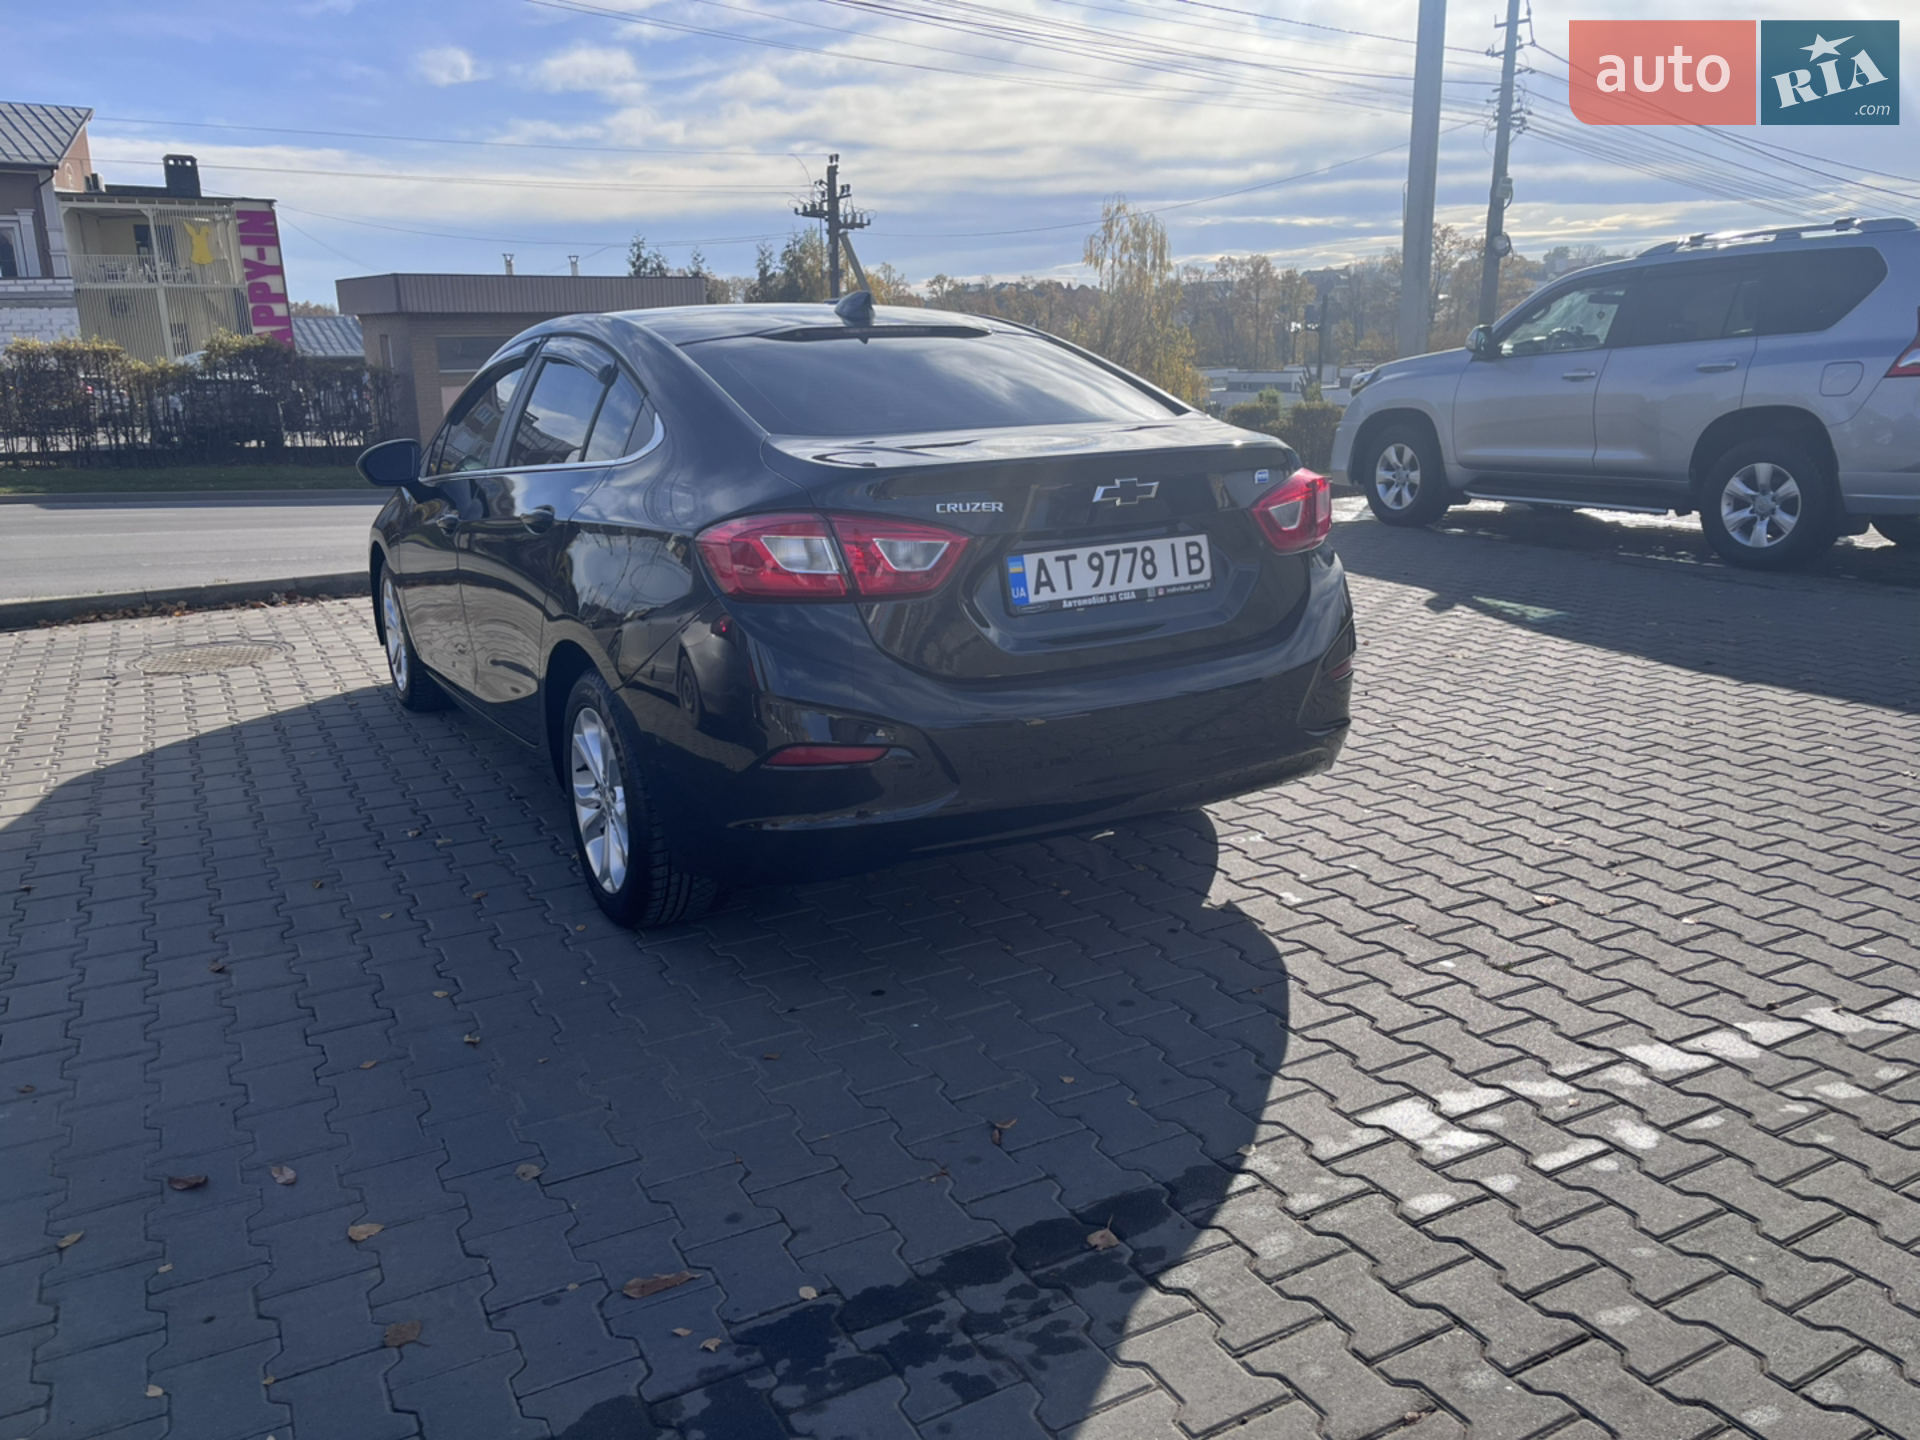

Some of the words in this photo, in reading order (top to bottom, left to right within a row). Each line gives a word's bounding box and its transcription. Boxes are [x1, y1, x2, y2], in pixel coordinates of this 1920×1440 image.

[935, 502, 1004, 514] CRUZER
[1033, 554, 1077, 596] AT
[1087, 546, 1158, 589] 9778
[1170, 541, 1206, 578] IB
[1011, 587, 1027, 599] UA
